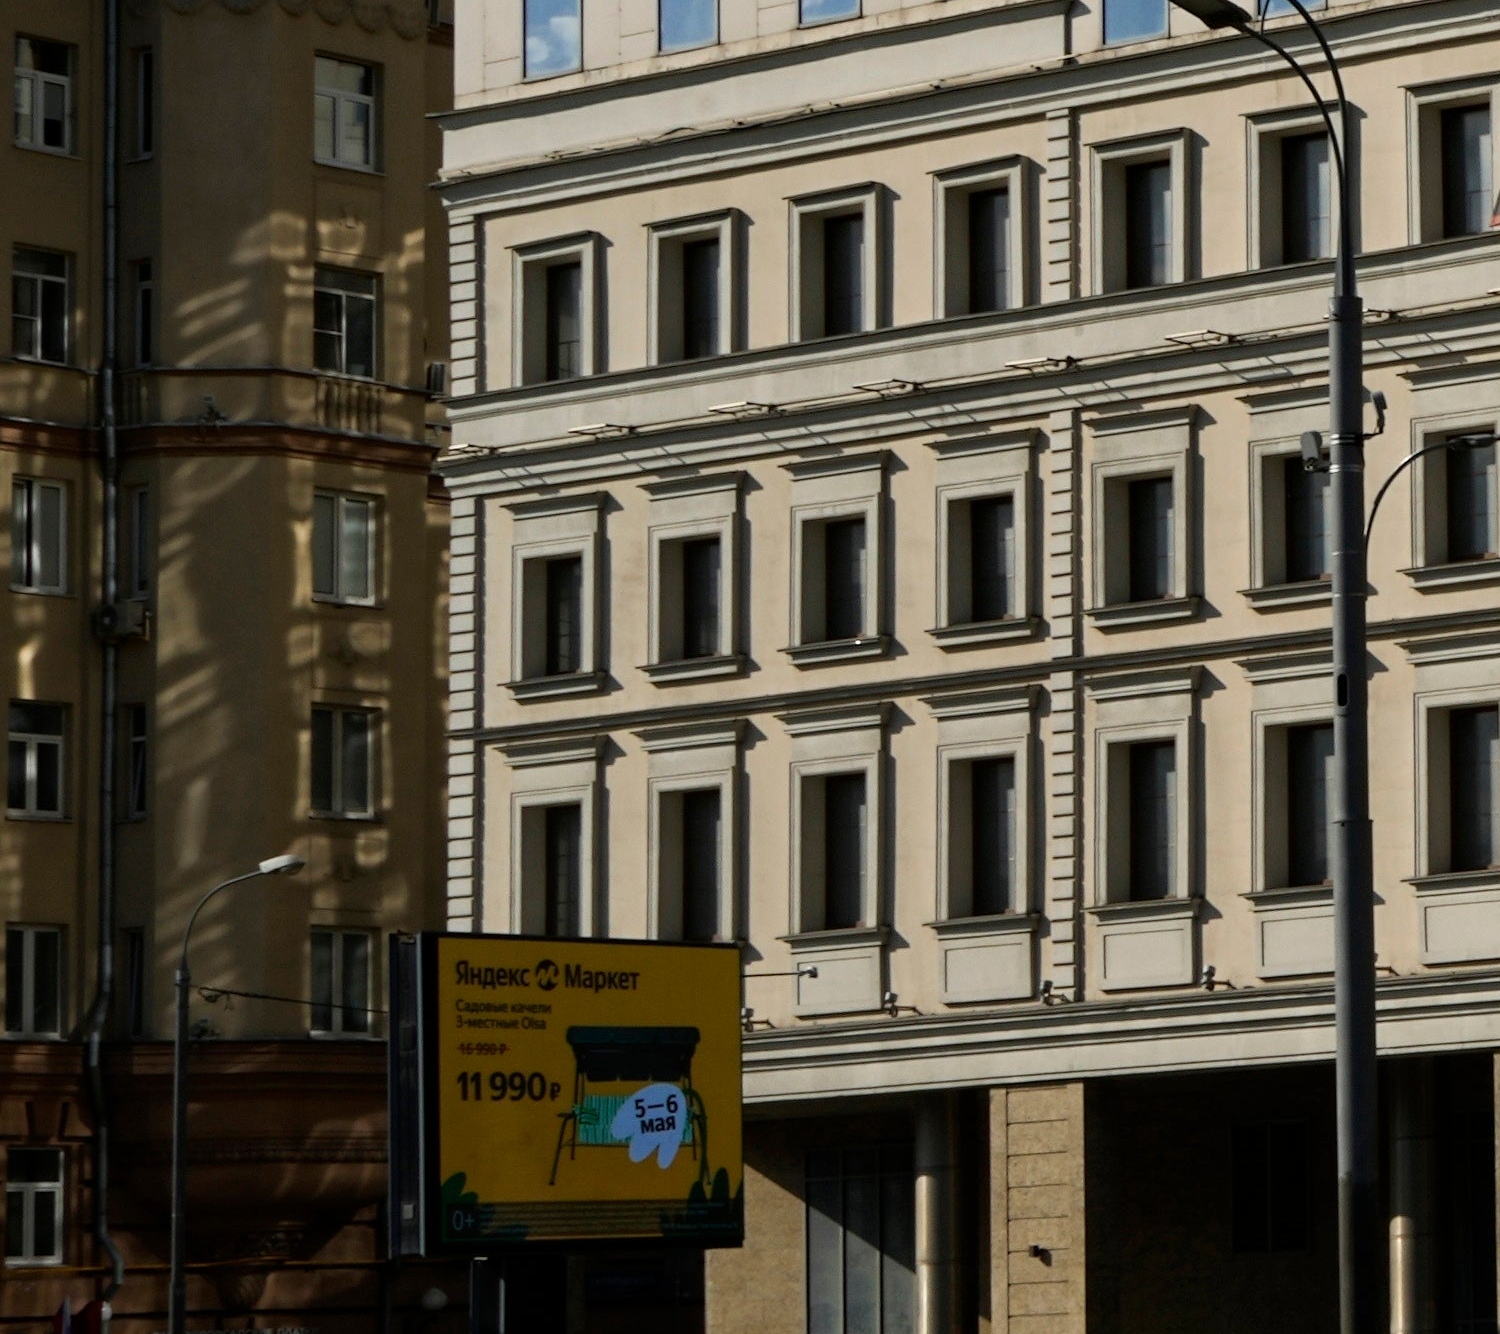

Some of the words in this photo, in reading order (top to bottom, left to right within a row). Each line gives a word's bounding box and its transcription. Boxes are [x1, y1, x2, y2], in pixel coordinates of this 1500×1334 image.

[455, 959, 531, 989] Яндекс
[565, 963, 640, 993] Маркет
[455, 998, 508, 1015] Садовые
[510, 1001, 553, 1014] качели
[455, 1014, 519, 1030] 3-местные
[456, 1072, 482, 1101] 11
[489, 1071, 547, 1101] 990
[640, 1115, 677, 1134] мая
[451, 1210, 475, 1231] 0+
